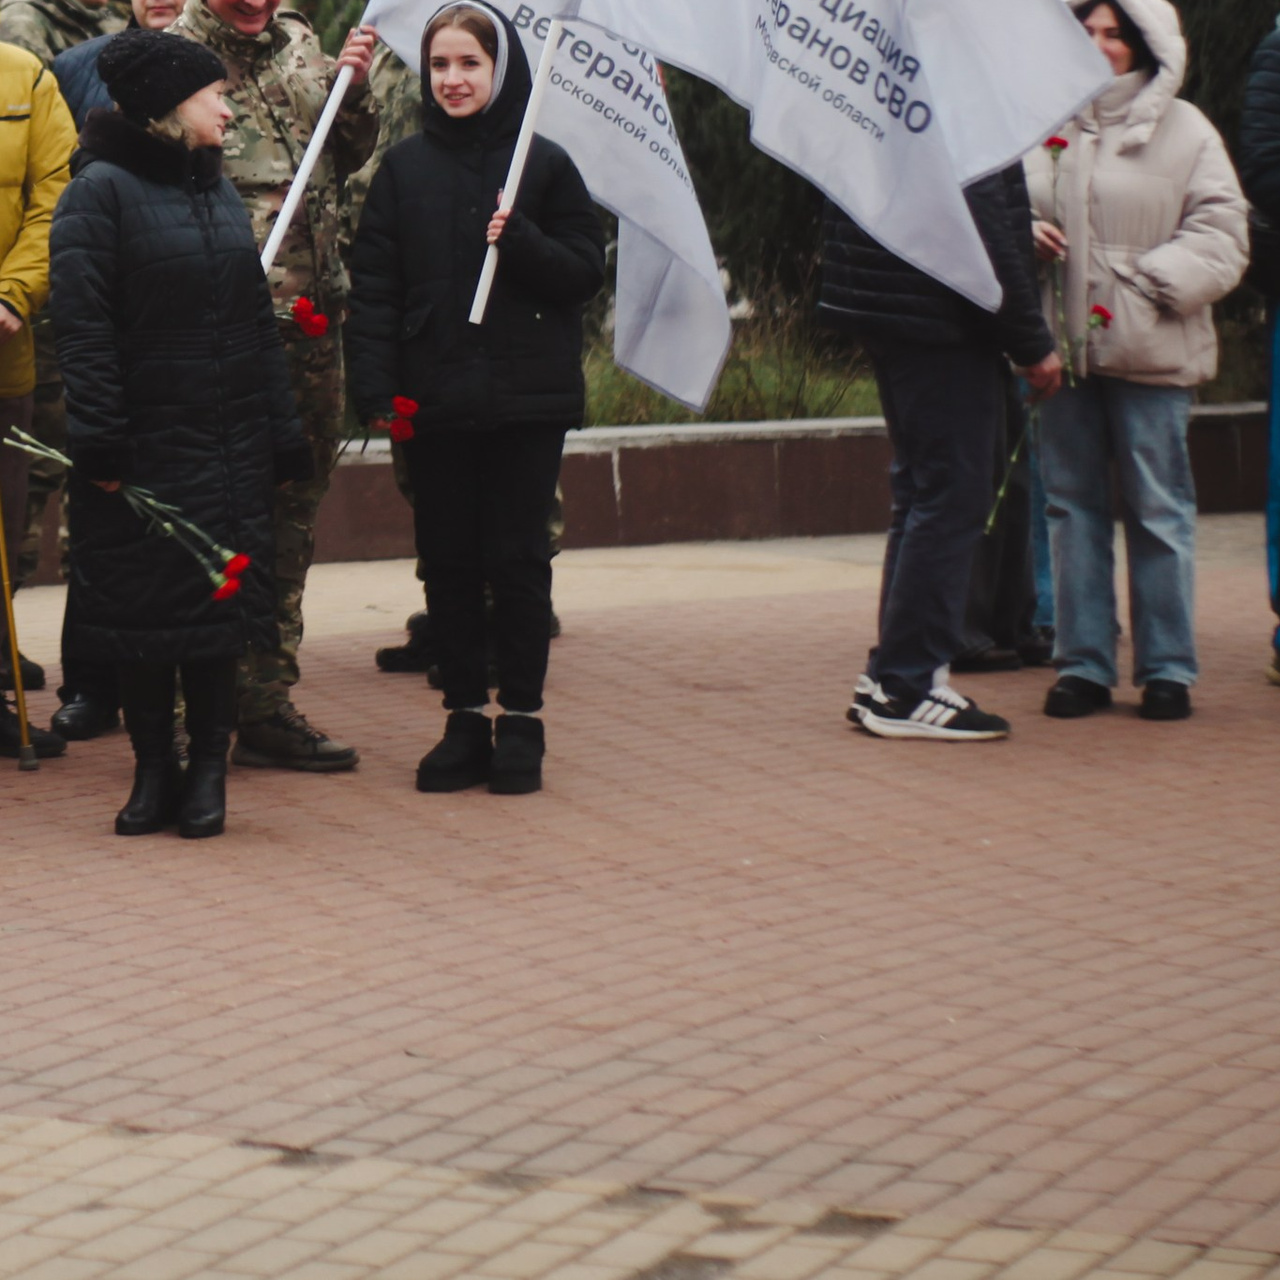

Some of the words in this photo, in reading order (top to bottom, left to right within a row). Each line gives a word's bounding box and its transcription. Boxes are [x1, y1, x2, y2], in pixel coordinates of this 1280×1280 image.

[542, 65, 648, 144] осковской
[822, 88, 885, 142] области
[874, 71, 932, 134] СВО
